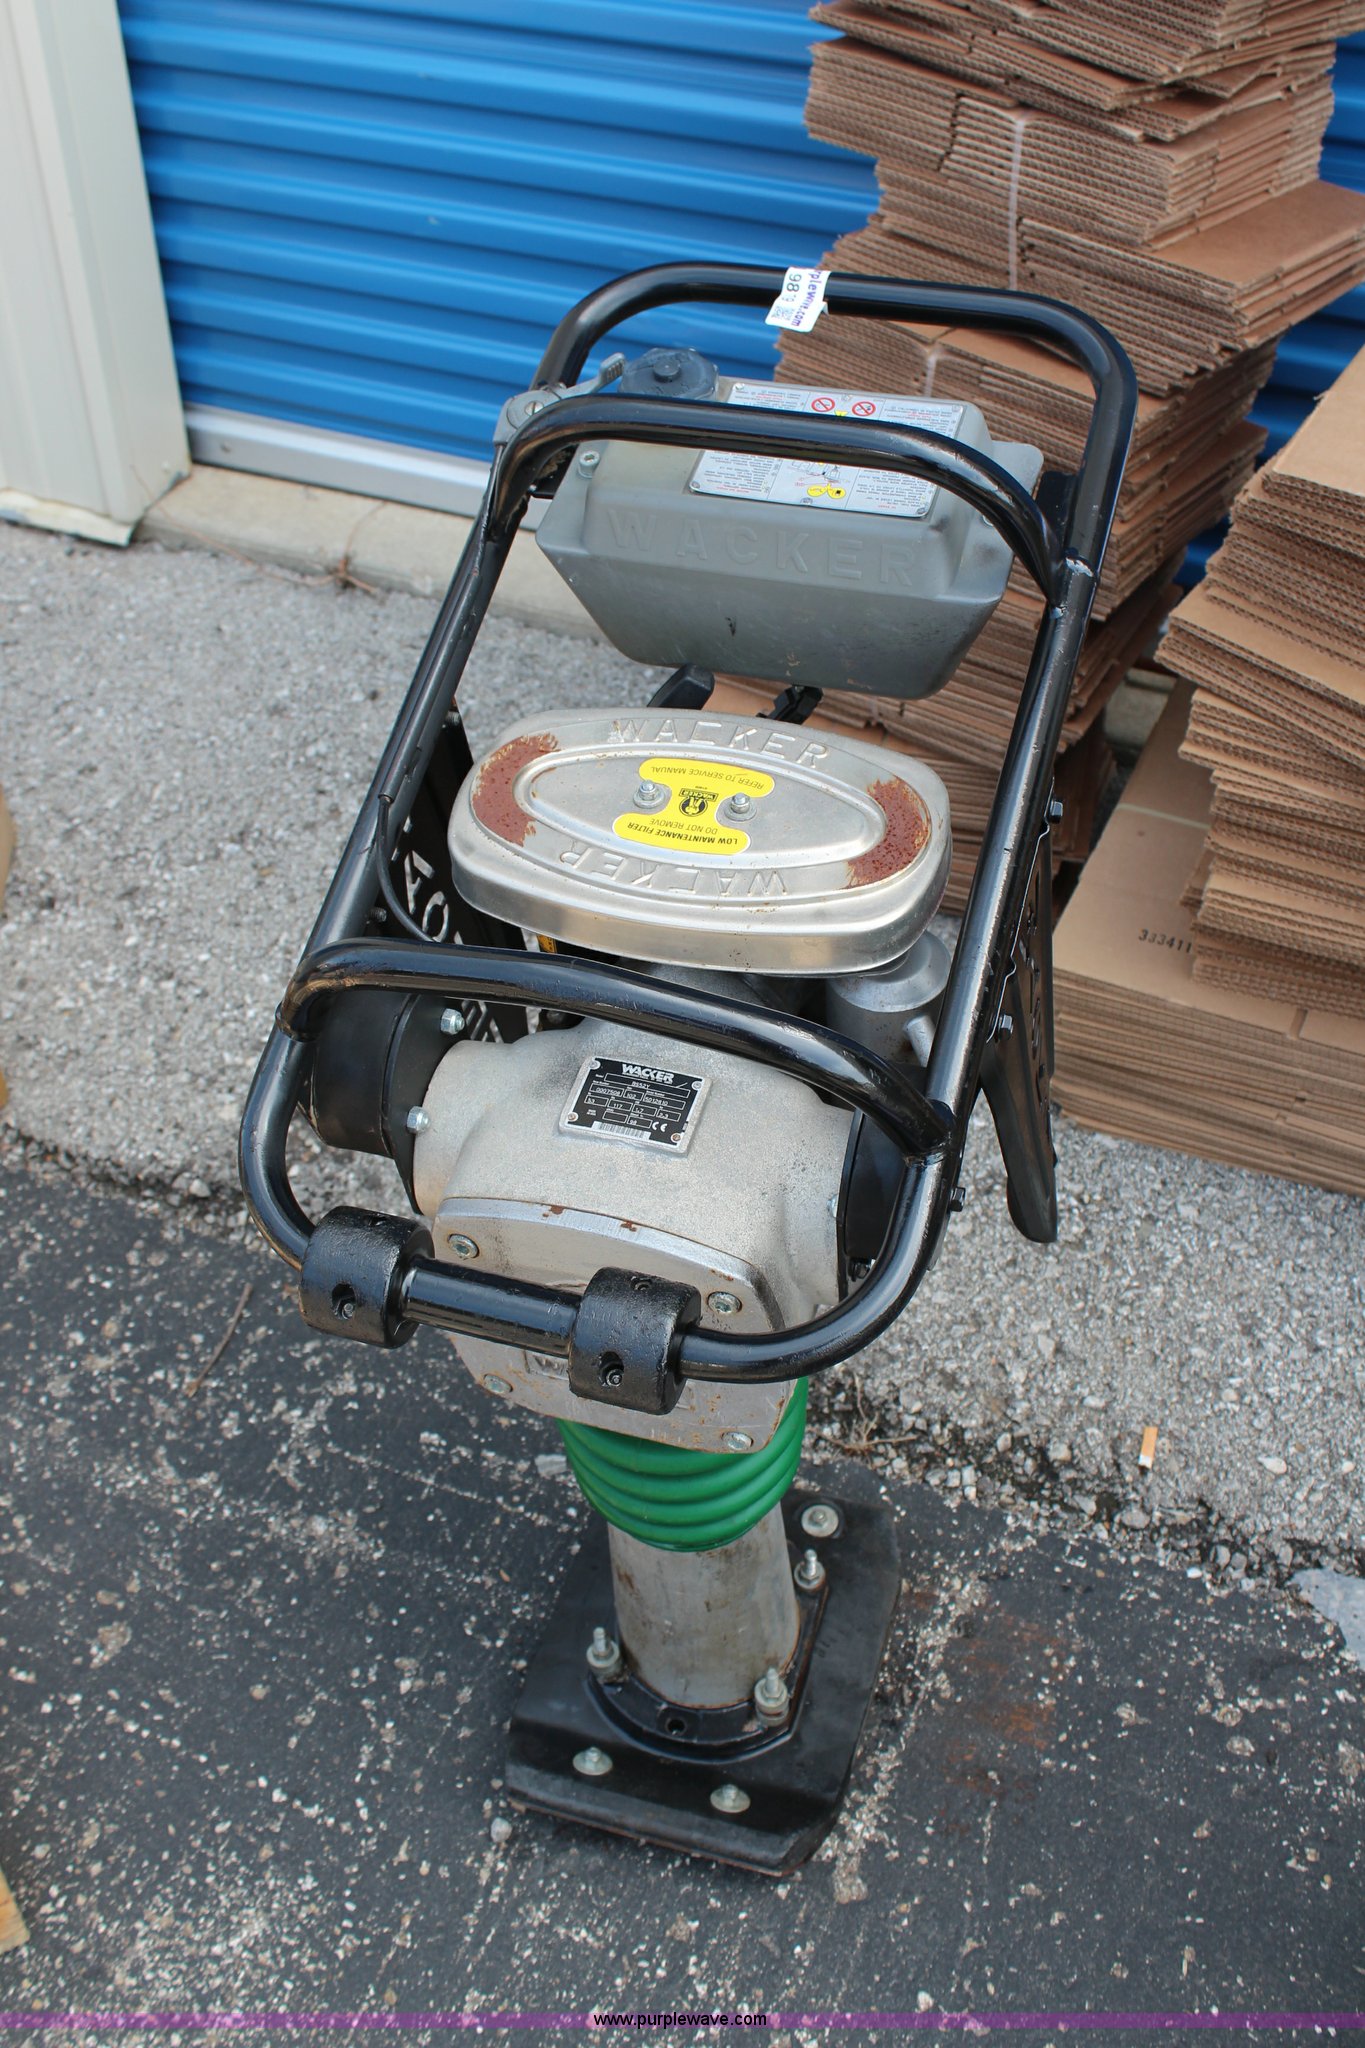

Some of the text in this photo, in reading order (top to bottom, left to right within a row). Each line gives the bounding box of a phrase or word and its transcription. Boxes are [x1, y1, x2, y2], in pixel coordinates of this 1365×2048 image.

[608, 508, 919, 587] WACKER
[607, 719, 829, 769] WACKER
[651, 766, 686, 775] MANUAL
[689, 768, 724, 779] SERVICE
[738, 777, 764, 789] REFER
[627, 822, 738, 845] LOW MAINTENANCE FILTER
[650, 818, 718, 835] DO NOT REMOVE
[560, 845, 788, 896] WACKER
[621, 1063, 675, 1085] WACKER
